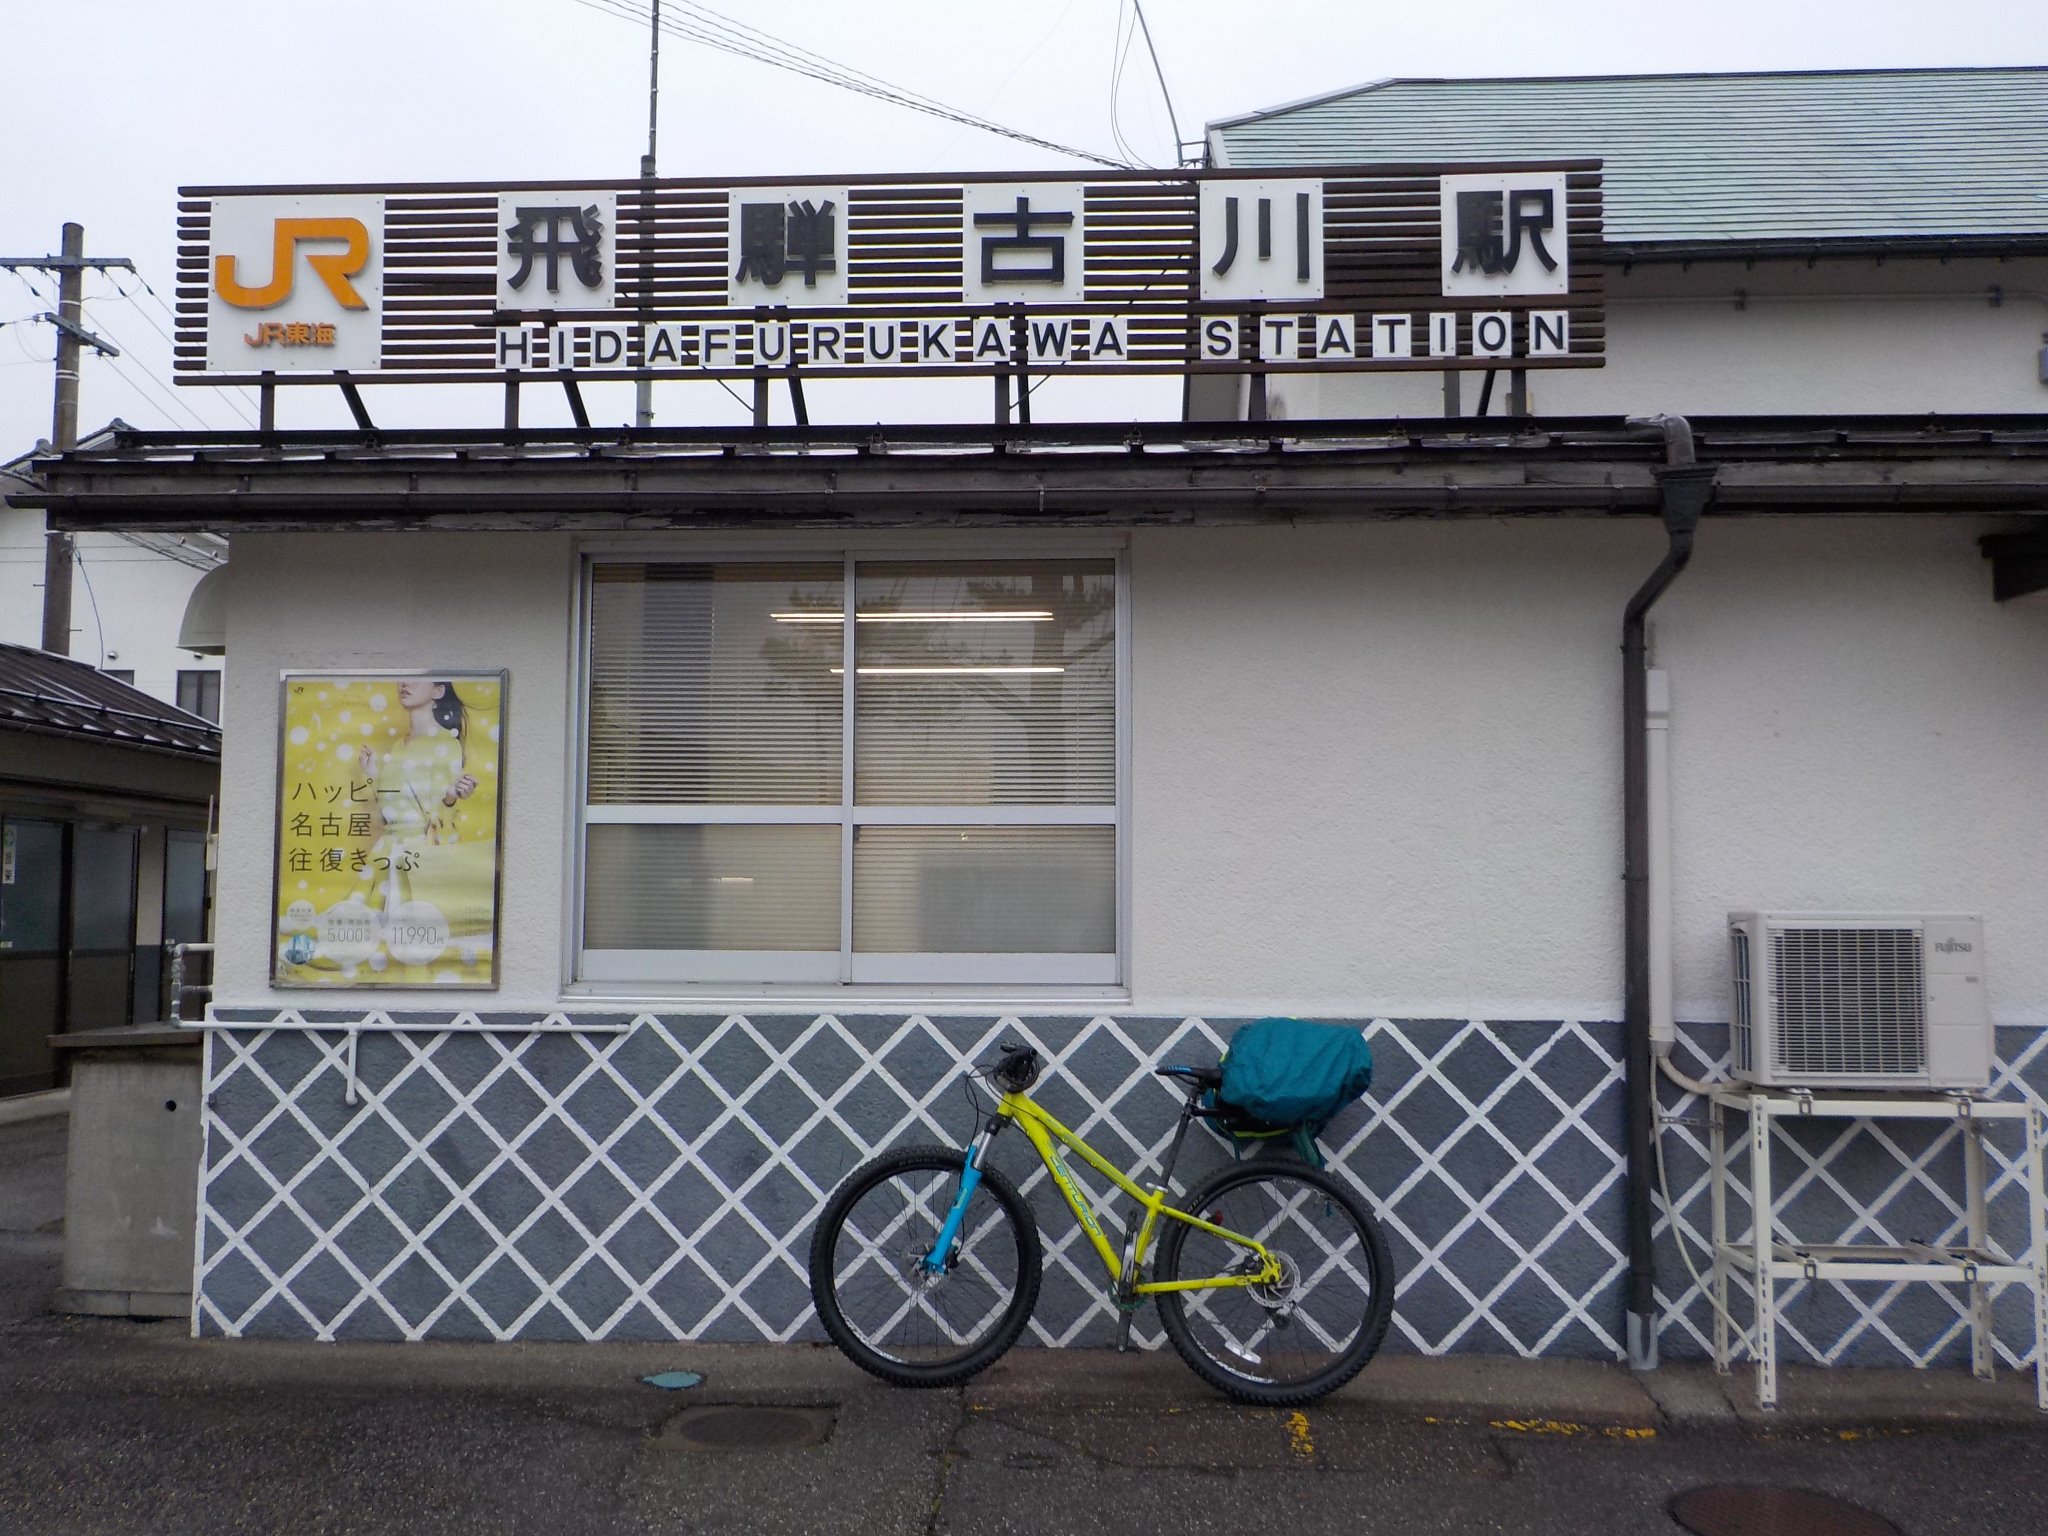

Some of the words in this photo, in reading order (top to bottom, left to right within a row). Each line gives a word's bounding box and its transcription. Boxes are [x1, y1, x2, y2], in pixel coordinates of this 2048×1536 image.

[506, 189, 1558, 293] 飛騨古川駅
[215, 217, 370, 312] JR
[243, 322, 336, 348] JR東海
[501, 321, 1123, 366] HIDAFURUKAWA
[1207, 315, 1566, 356] STATION
[292, 778, 401, 804] ハッピー
[290, 812, 372, 838] 名古屋
[289, 847, 420, 873] 往復きっぷ
